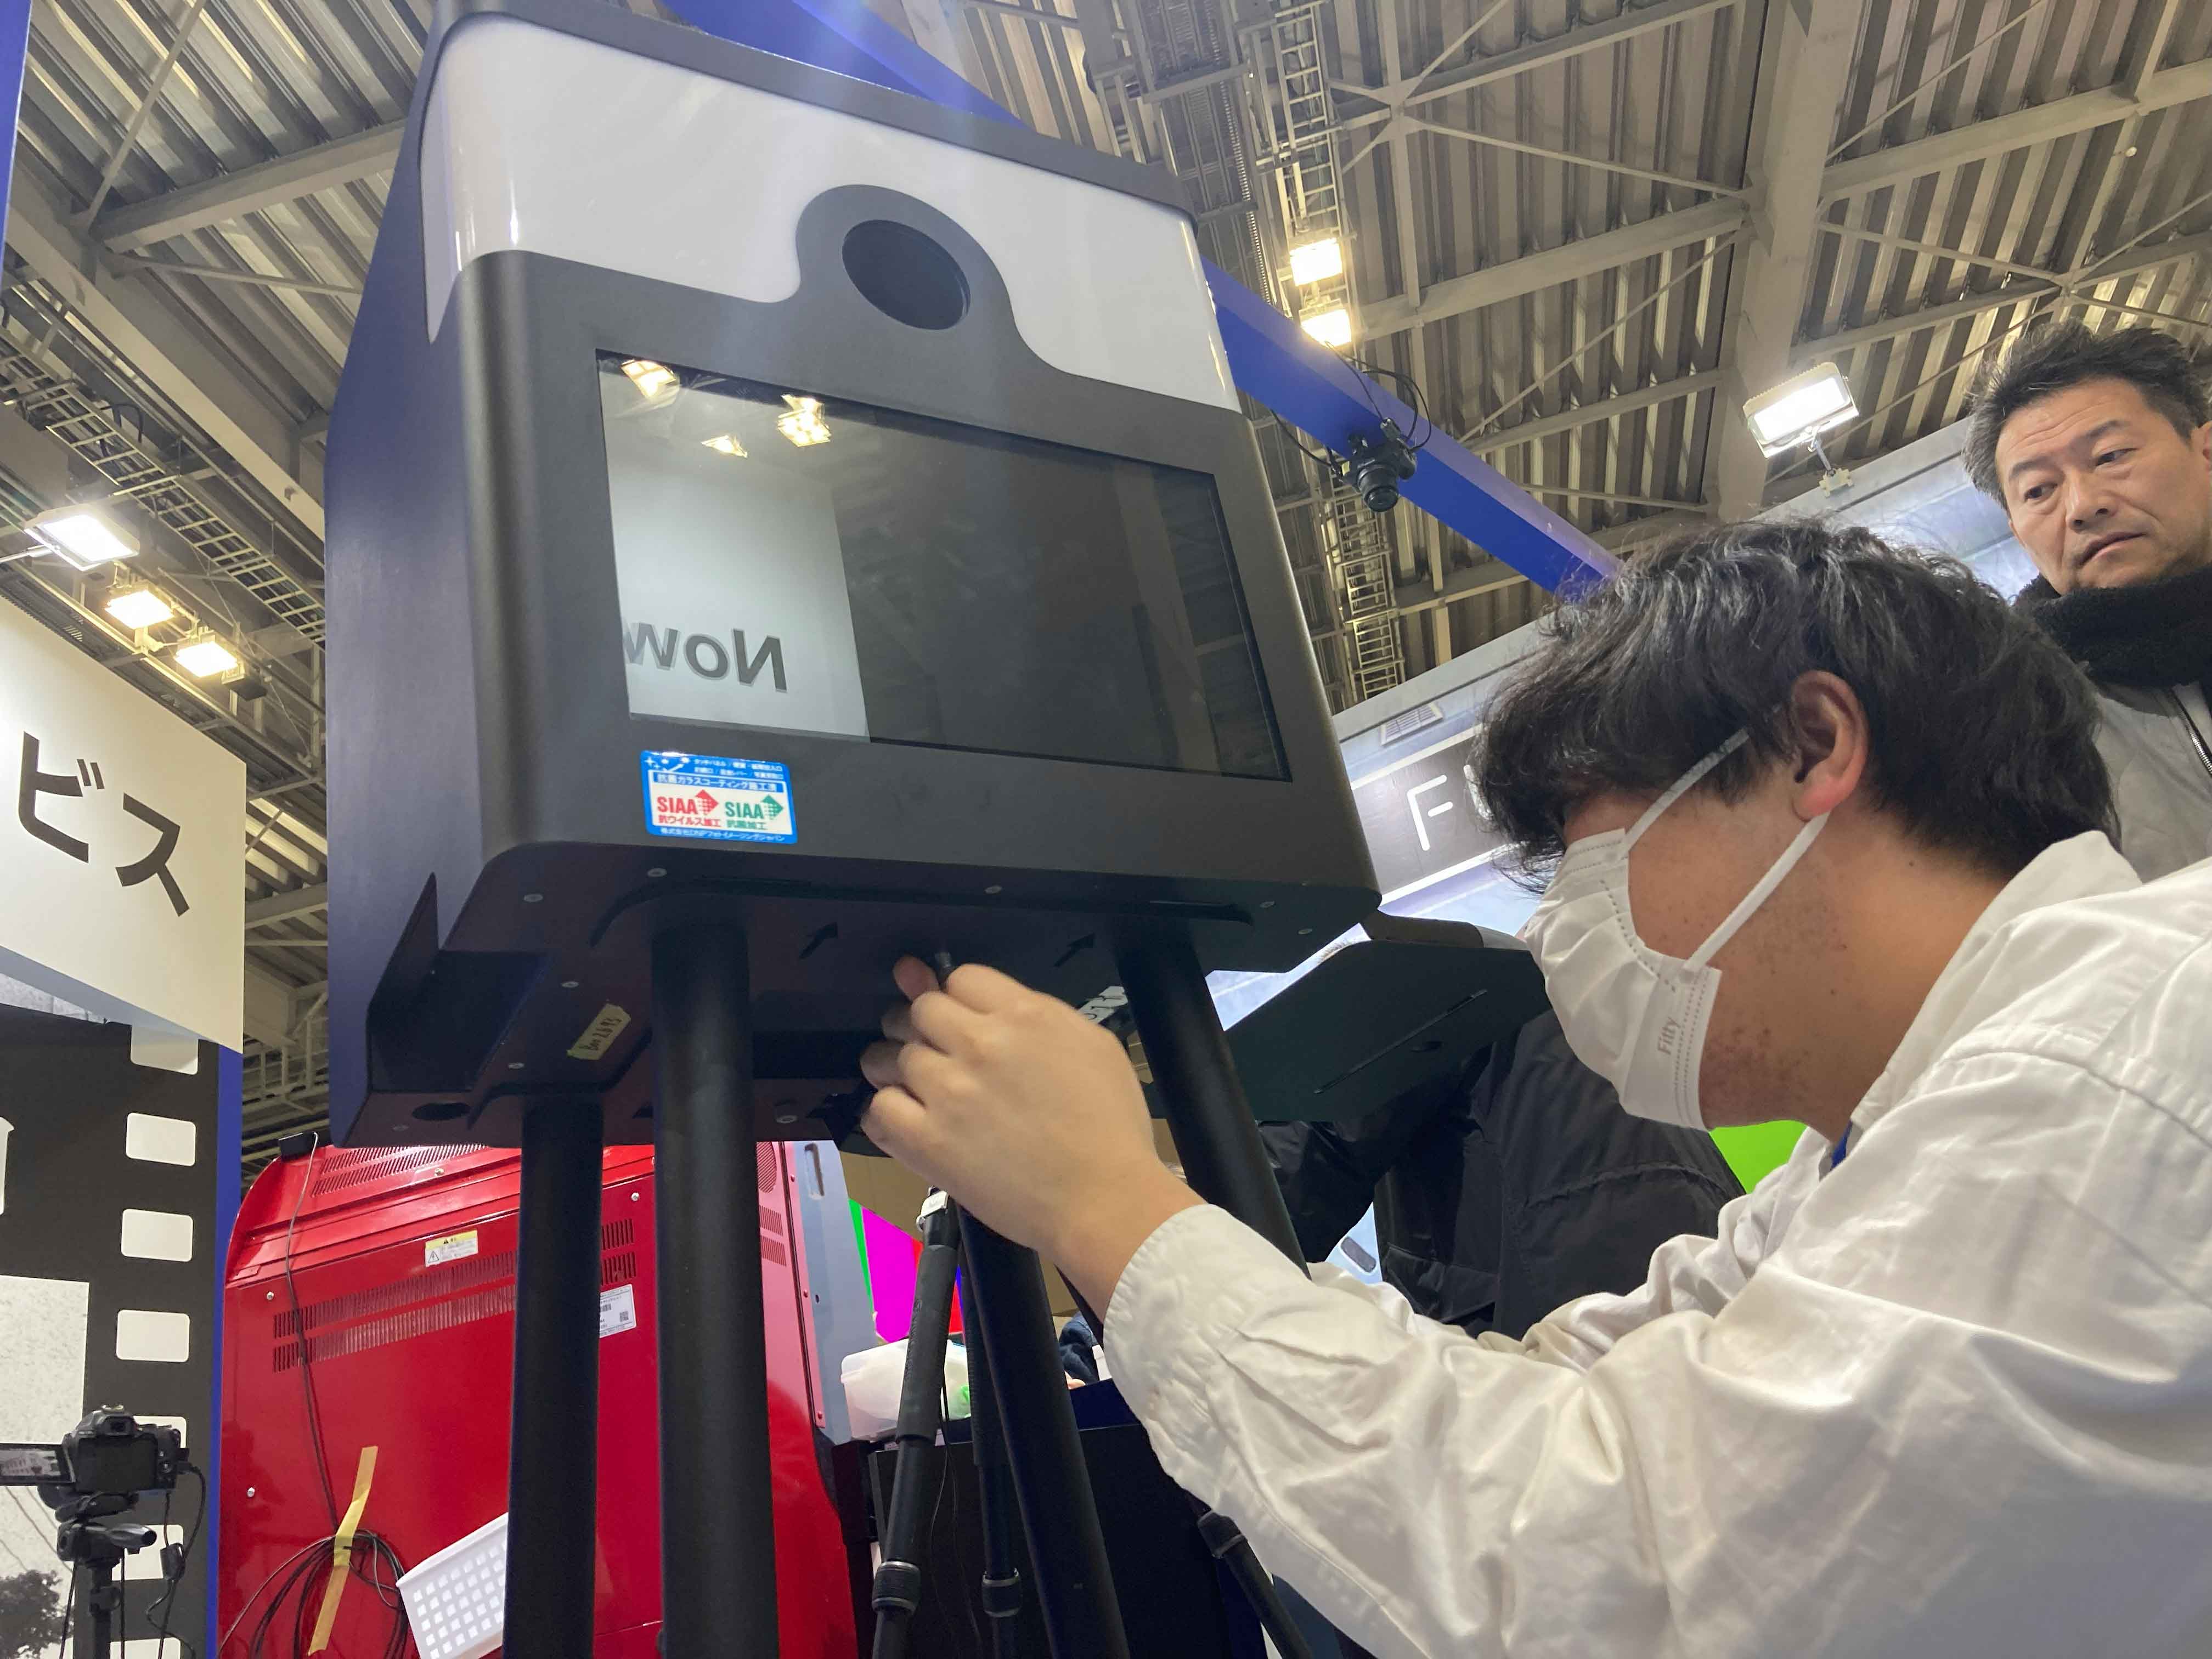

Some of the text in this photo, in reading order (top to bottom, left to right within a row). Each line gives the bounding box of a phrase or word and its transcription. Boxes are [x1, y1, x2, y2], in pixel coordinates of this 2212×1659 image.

[657, 796, 698, 815] SIAA
[725, 802, 764, 819] SIAA
[18, 731, 189, 917] ビス
[1657, 1016, 1681, 1056] Fitty
